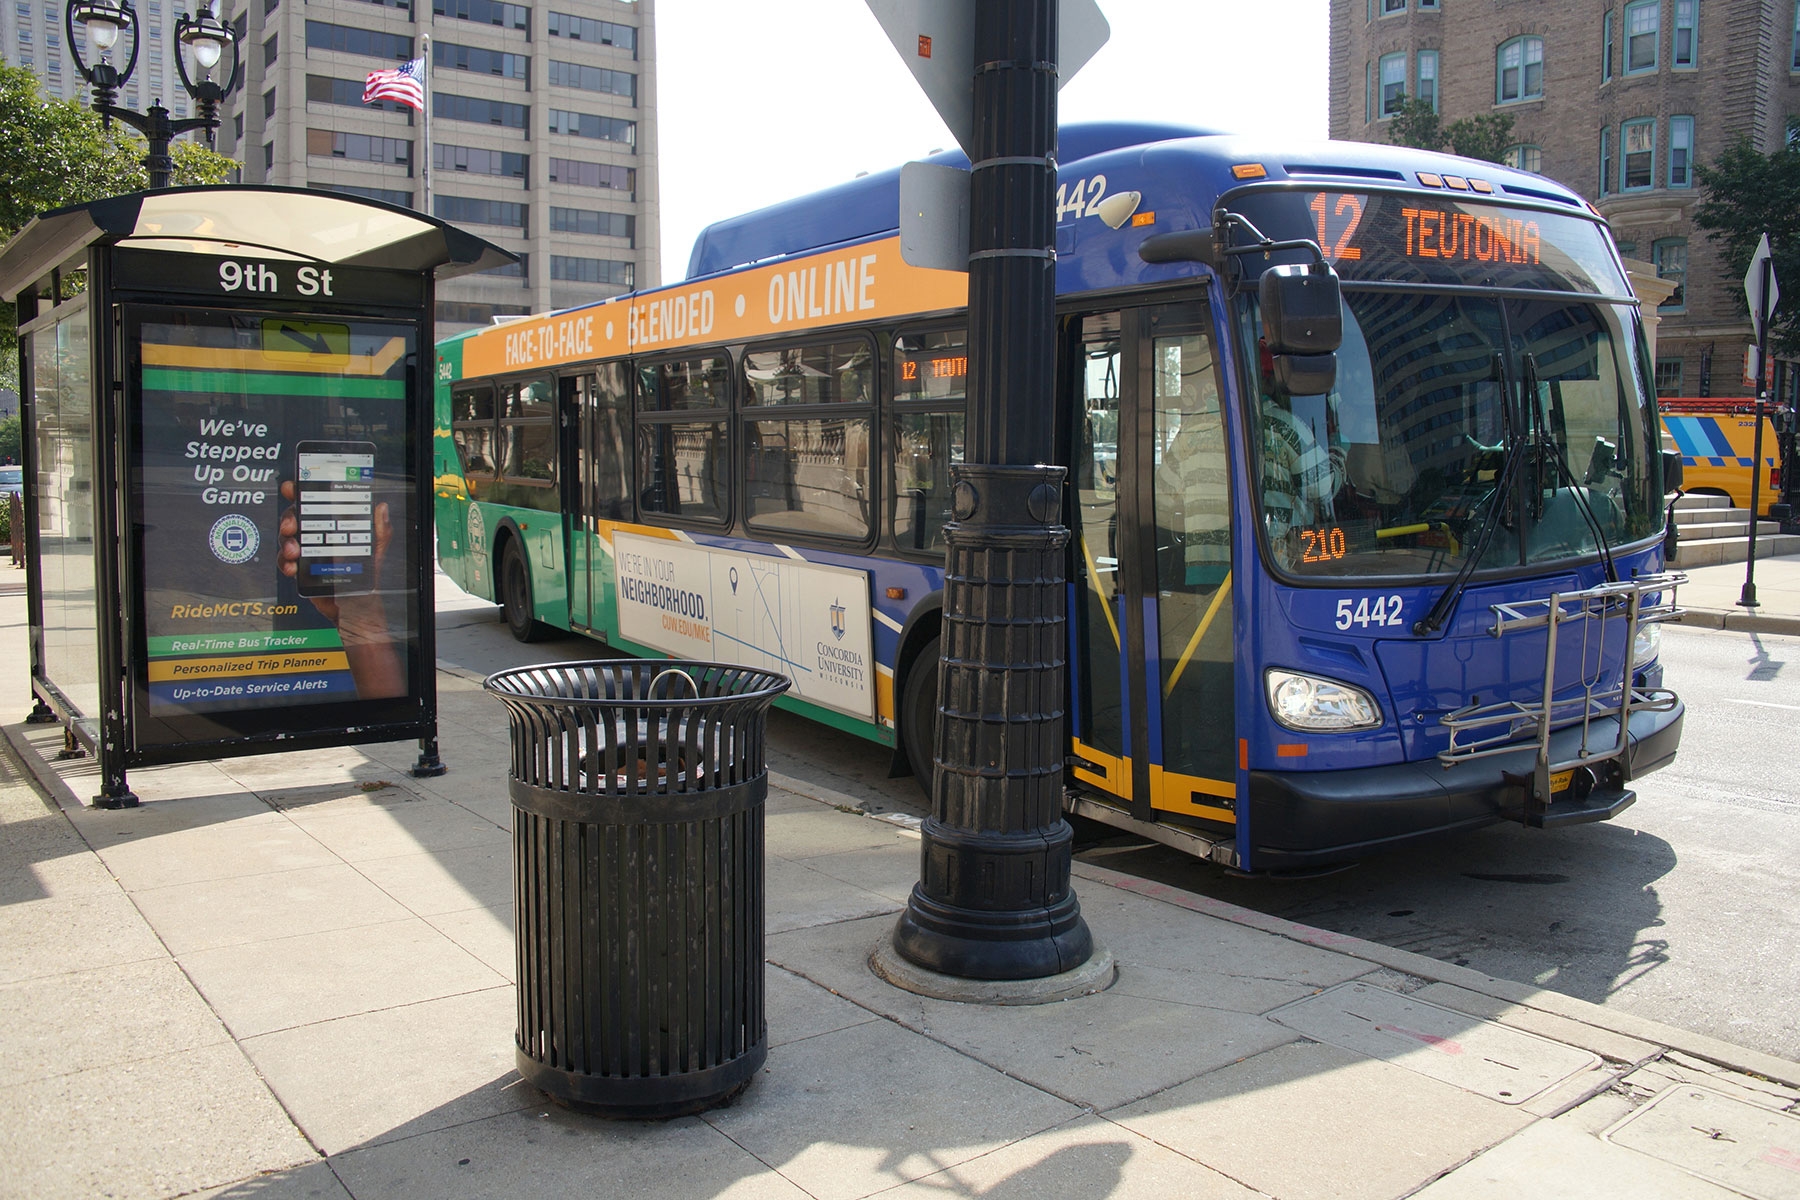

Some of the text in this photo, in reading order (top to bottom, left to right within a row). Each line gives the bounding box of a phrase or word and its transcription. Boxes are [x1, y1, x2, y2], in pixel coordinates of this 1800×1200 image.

[1309, 192, 1541, 265] 12 TEUTONIA
[218, 261, 334, 297] 9th St
[505, 254, 877, 367] FACE-TO-FACE BLENDED ONLINE
[437, 361, 452, 380] 5442
[902, 361, 916, 380] 12
[199, 418, 268, 438] We've
[185, 441, 281, 461] Stepped
[193, 465, 274, 485] Up Our
[201, 488, 266, 505] Game
[214, 519, 255, 540] MILWAUKEE
[217, 546, 251, 559] COUNTY
[1300, 527, 1346, 564] 210
[619, 552, 675, 583] WE'RE IN YOUR
[621, 576, 709, 622] NEIGHBORHOOD.
[171, 603, 298, 620] RideMCTS.com
[1335, 595, 1404, 631] 5442
[662, 614, 710, 643] CUW.EDU/MKE
[171, 635, 308, 652] Real-Time Bus Tracker
[817, 641, 863, 666] CONCORDIA
[173, 656, 328, 675] Personalized Trip Planner
[818, 656, 864, 681] UNIVERSITY
[173, 679, 328, 701] Up-to-Date Service Alerts
